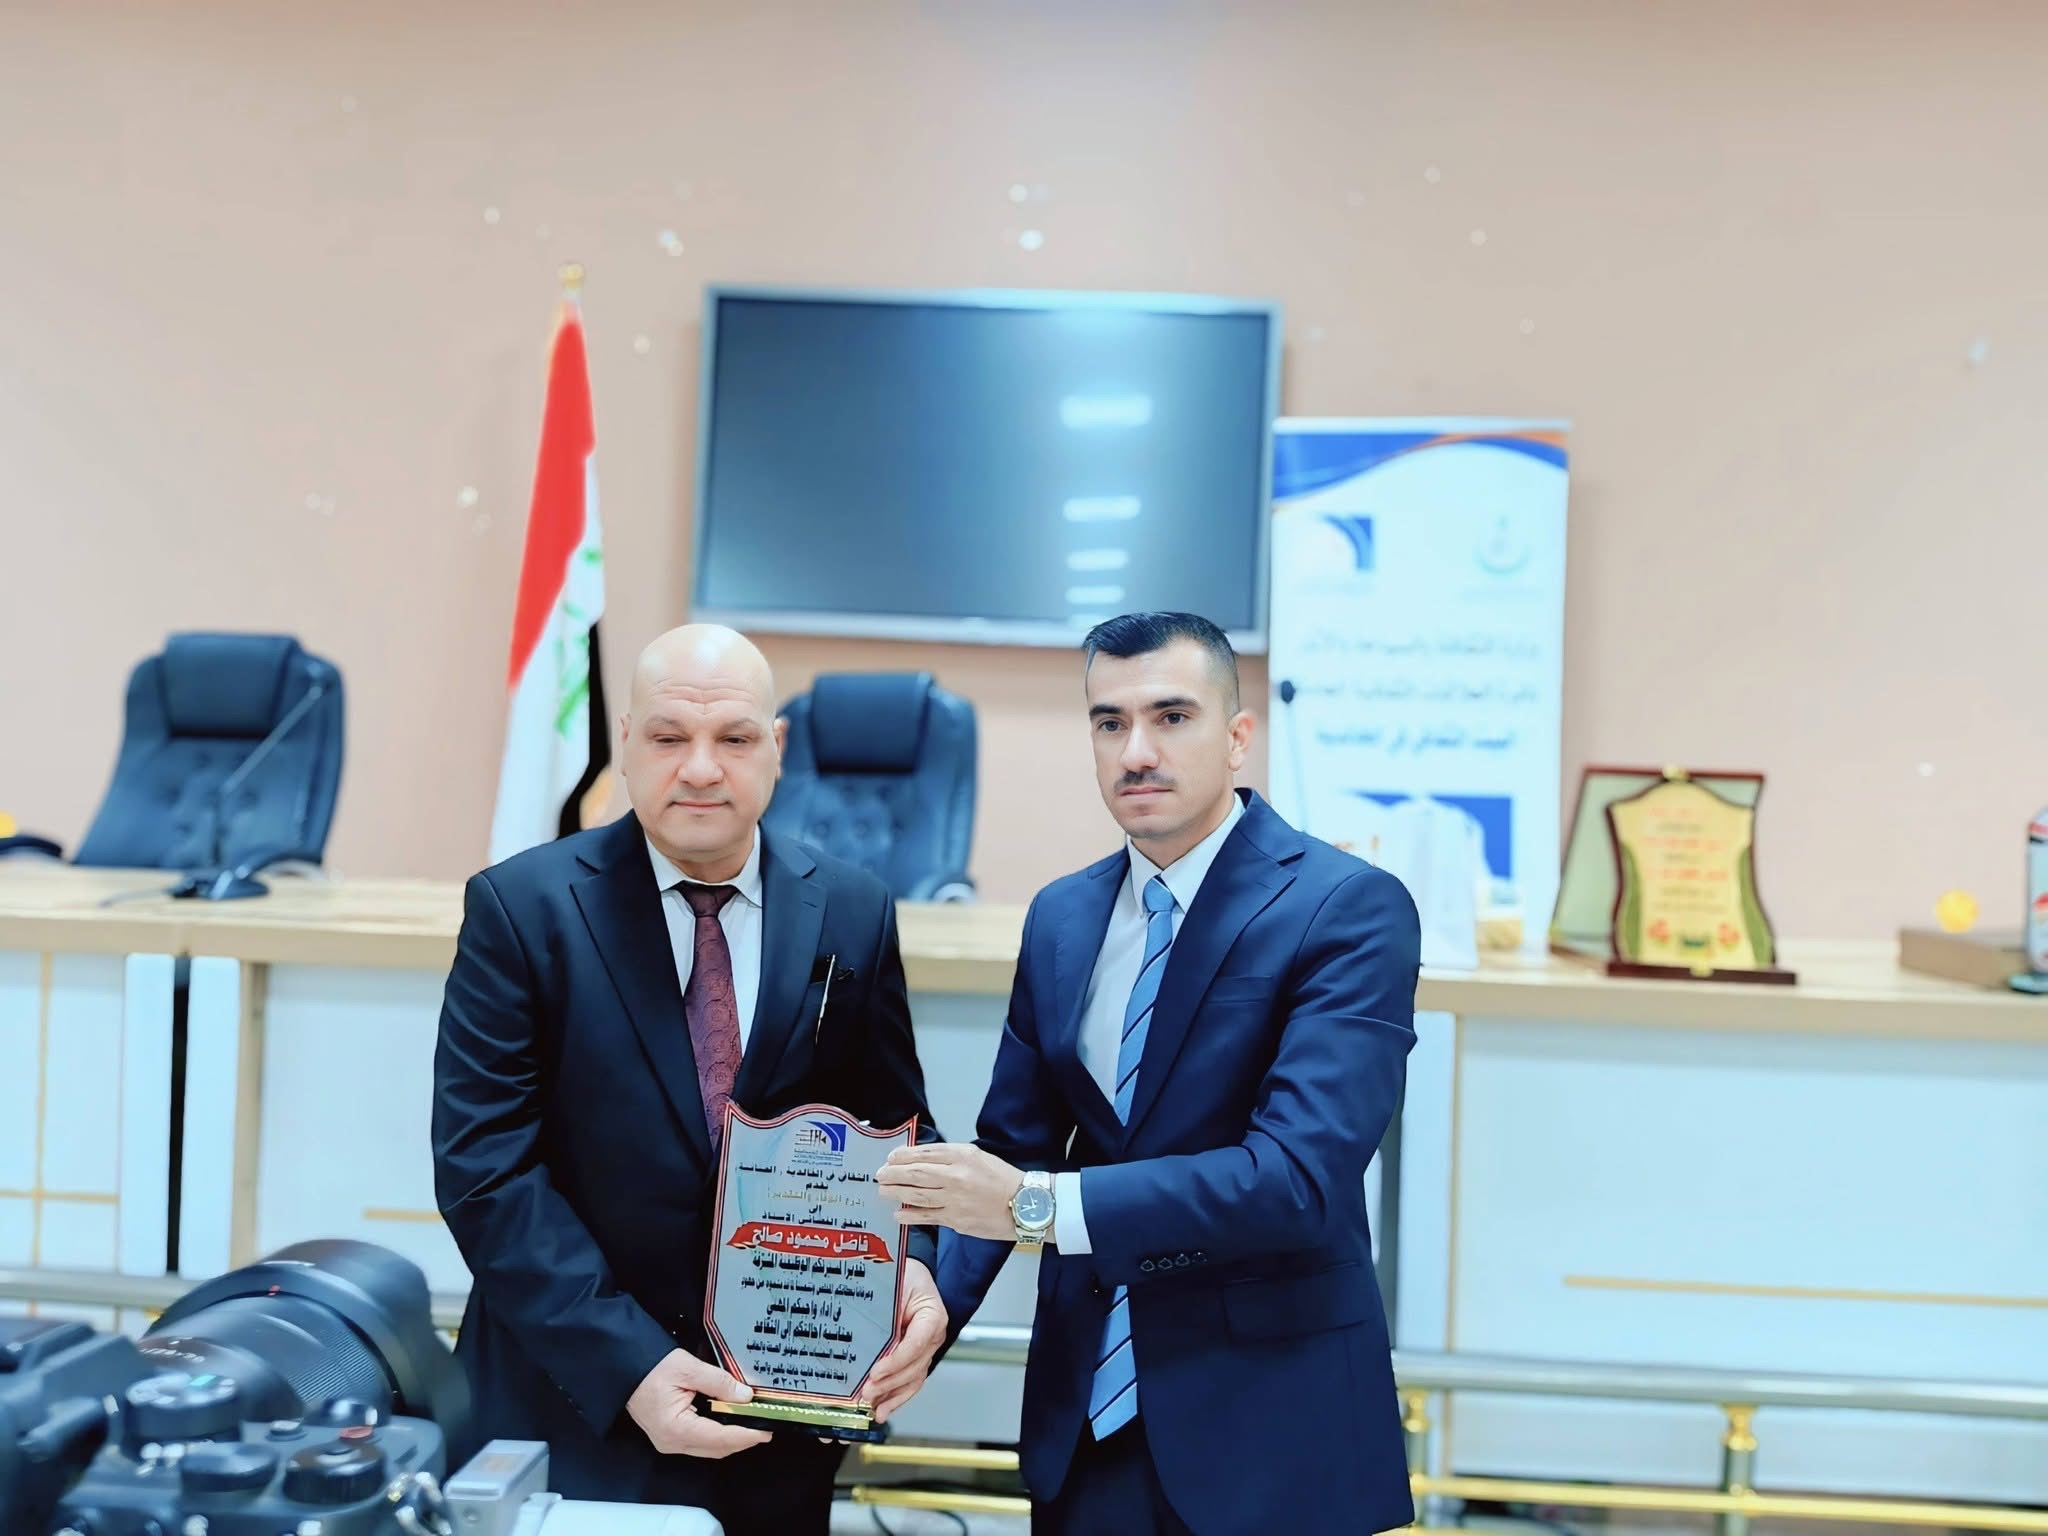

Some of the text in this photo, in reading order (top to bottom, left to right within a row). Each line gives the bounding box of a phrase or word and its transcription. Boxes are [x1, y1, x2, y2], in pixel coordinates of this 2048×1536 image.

[752, 1225, 869, 1253] فاضل محمود صالح
[823, 1323, 853, 1343] بمناسبة
